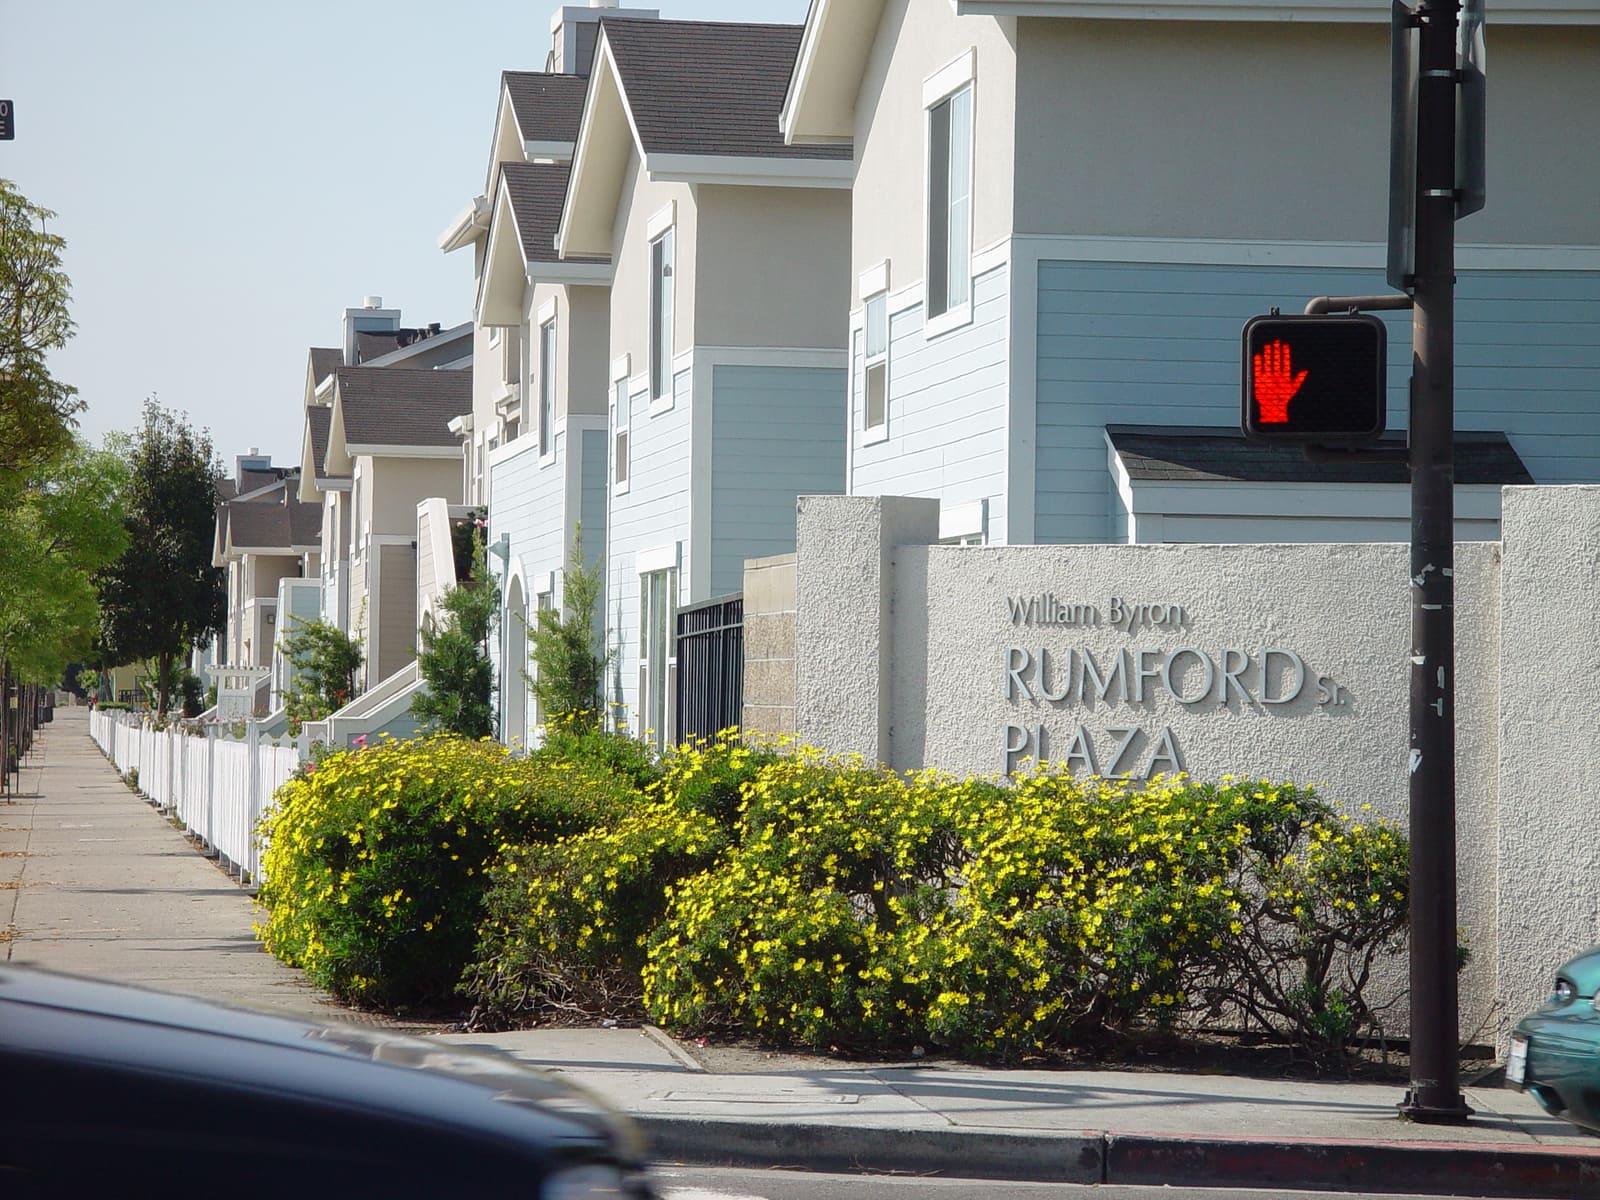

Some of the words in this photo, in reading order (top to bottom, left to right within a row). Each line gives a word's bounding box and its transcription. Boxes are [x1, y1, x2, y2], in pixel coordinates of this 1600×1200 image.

[1006, 592, 1096, 625] William
[1109, 595, 1184, 632] Byron
[1004, 647, 1304, 704] RUMFORD
